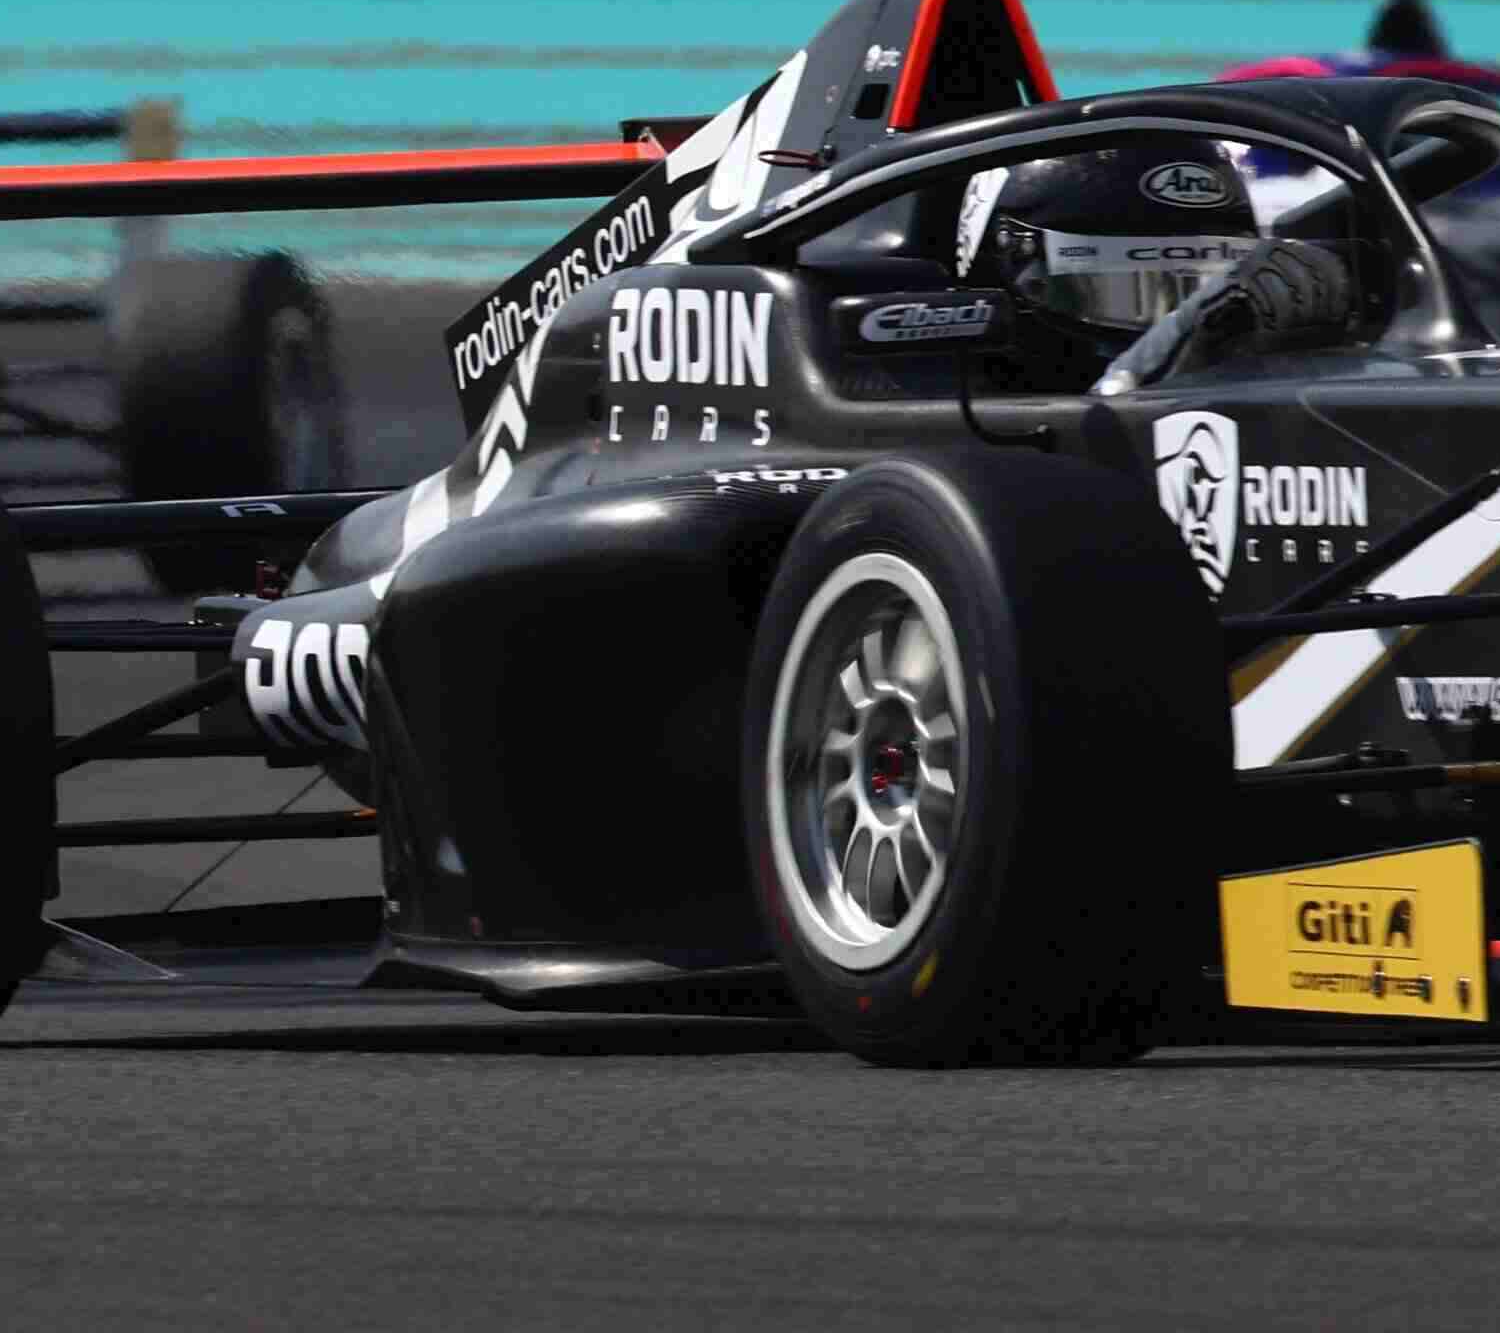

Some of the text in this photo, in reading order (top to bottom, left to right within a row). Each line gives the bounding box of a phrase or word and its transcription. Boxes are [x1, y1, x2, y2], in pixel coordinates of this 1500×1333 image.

[453, 195, 656, 390] rodin-cars.com
[860, 298, 995, 342] Eibach
[608, 287, 774, 387] RODIN
[608, 402, 773, 447] CARS
[1241, 464, 1369, 527] RODIN
[1298, 899, 1371, 946] Giti
